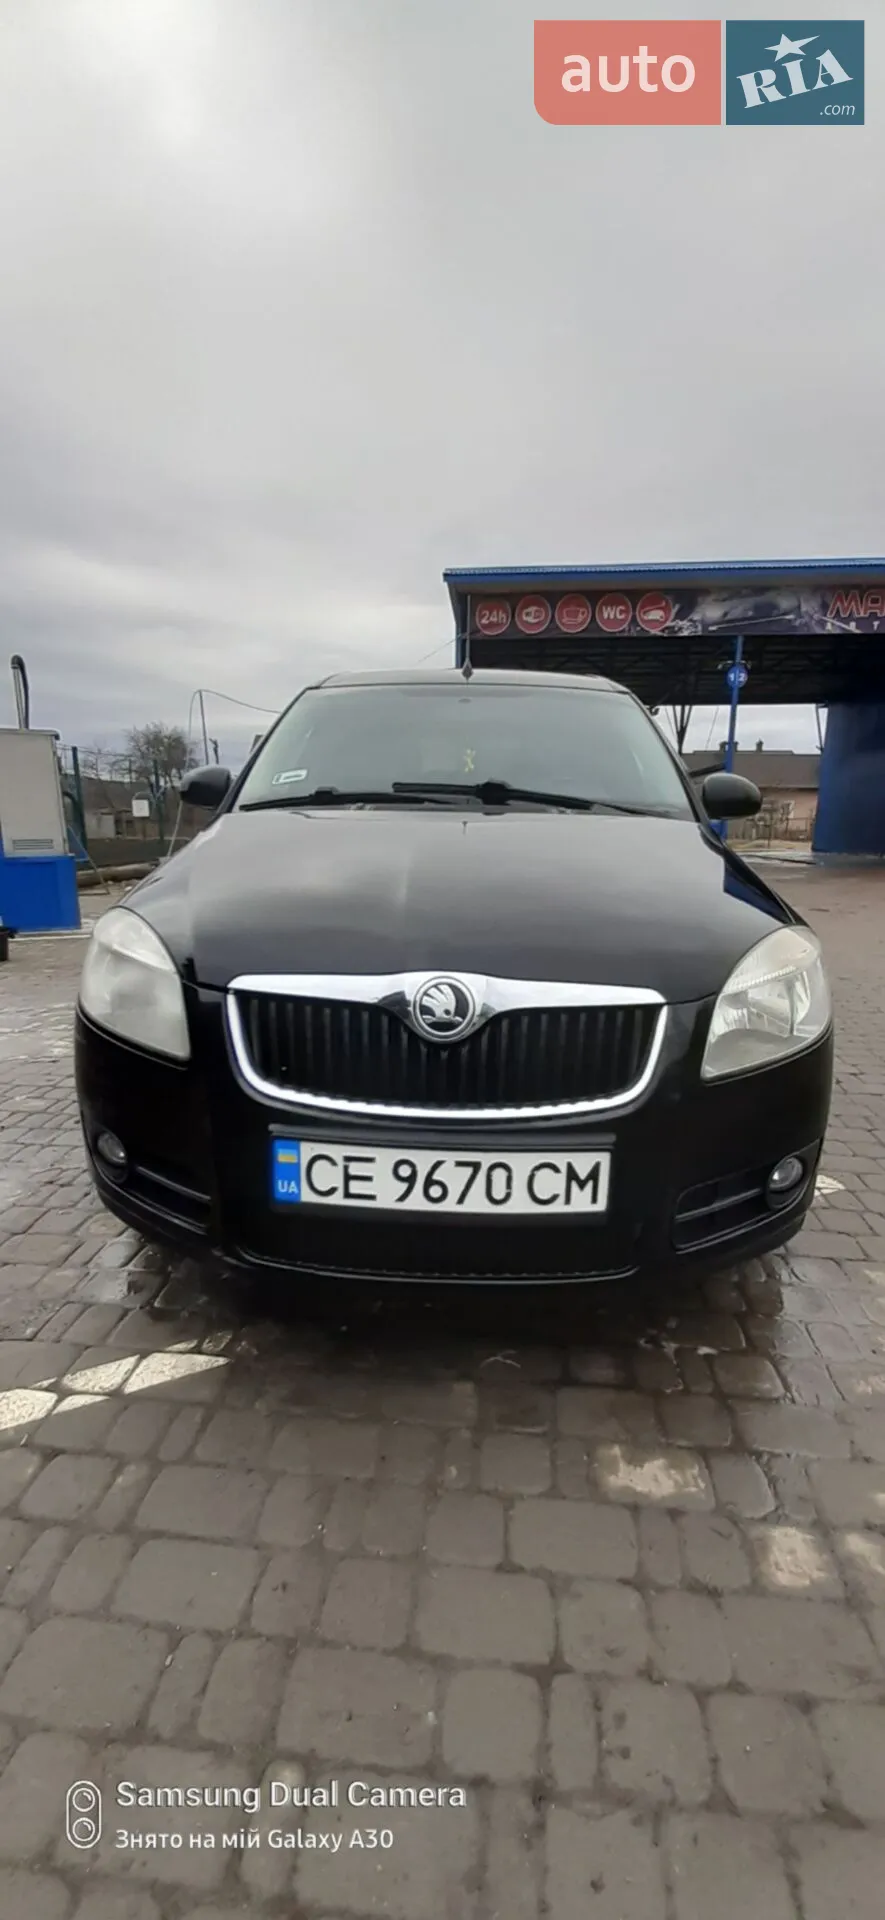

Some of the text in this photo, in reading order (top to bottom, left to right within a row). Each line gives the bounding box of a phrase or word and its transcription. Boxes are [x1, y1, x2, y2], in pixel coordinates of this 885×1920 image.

[480, 610, 507, 625] 24h
[602, 605, 626, 621] WC
[277, 1179, 299, 1194] UA
[305, 1153, 601, 1206] CE 9670 CM
